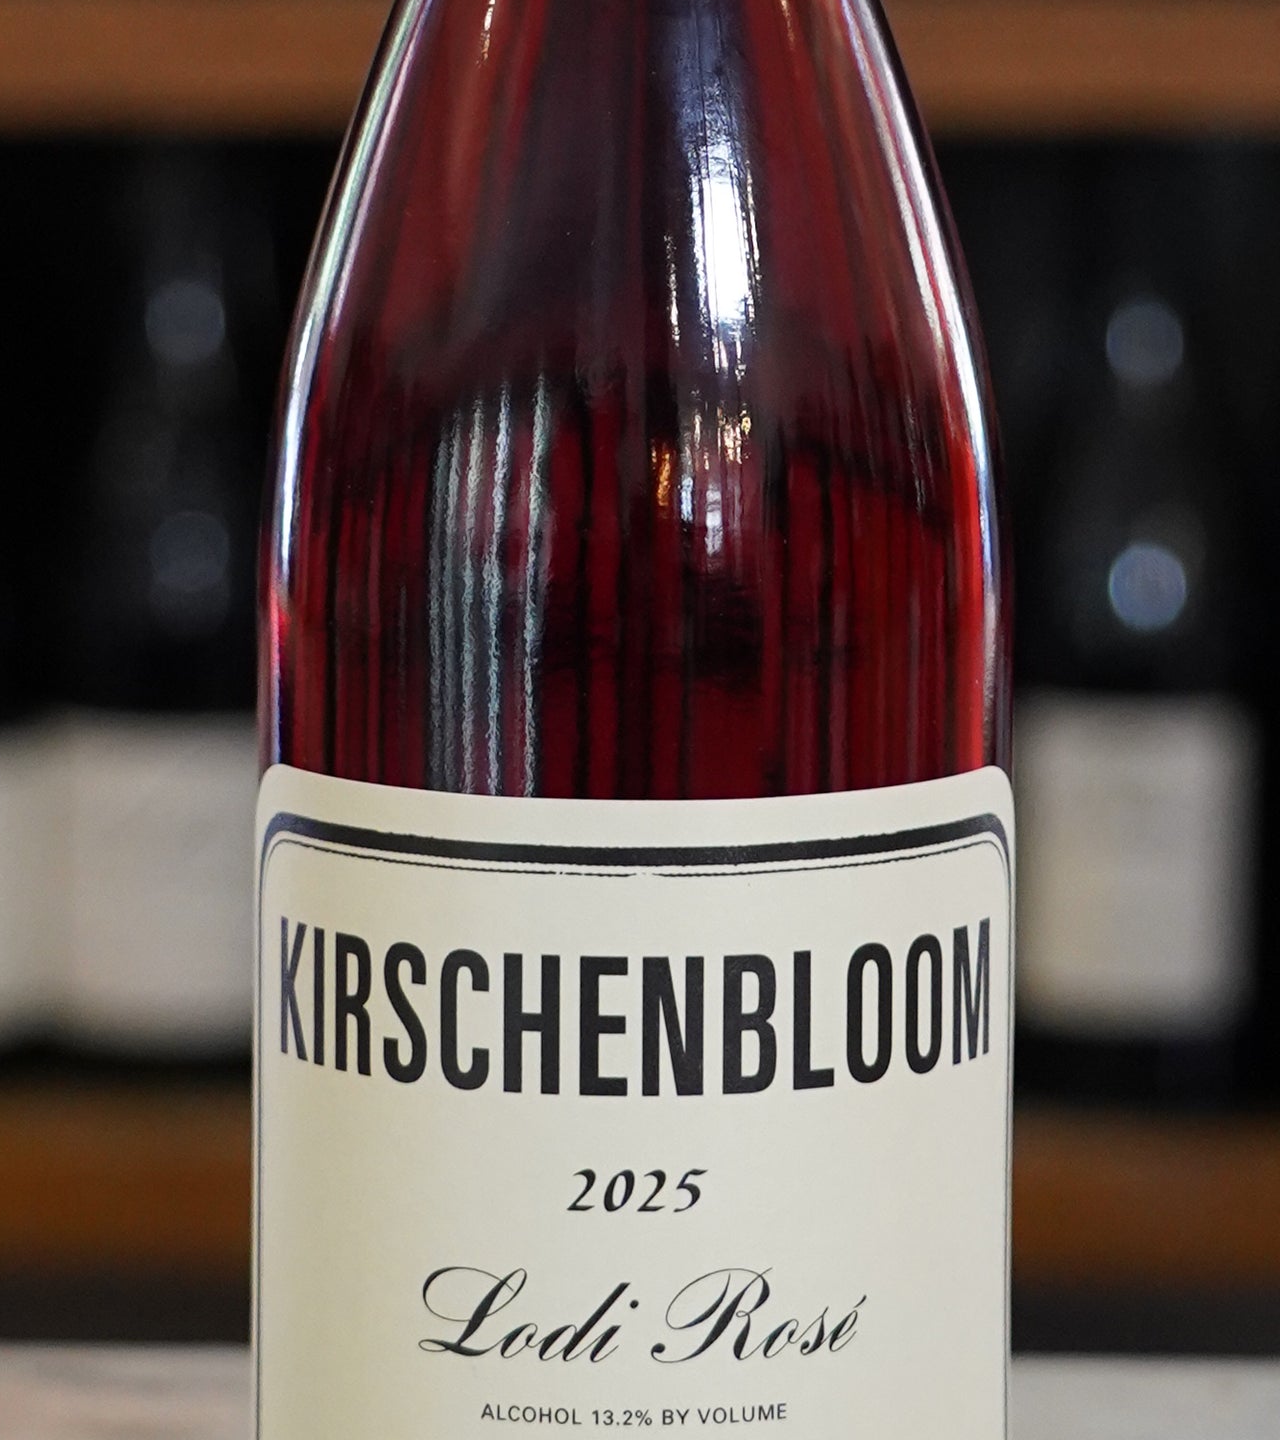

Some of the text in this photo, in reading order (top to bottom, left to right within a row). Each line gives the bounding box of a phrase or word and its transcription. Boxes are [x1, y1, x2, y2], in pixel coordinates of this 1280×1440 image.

[279, 915, 991, 1098] KIRSCHENBLOOM
[566, 1168, 709, 1214] 2025
[417, 1266, 868, 1364] Lodi Rosé
[480, 1402, 787, 1427] ALCOHOL 13.2% BY VOLUME
